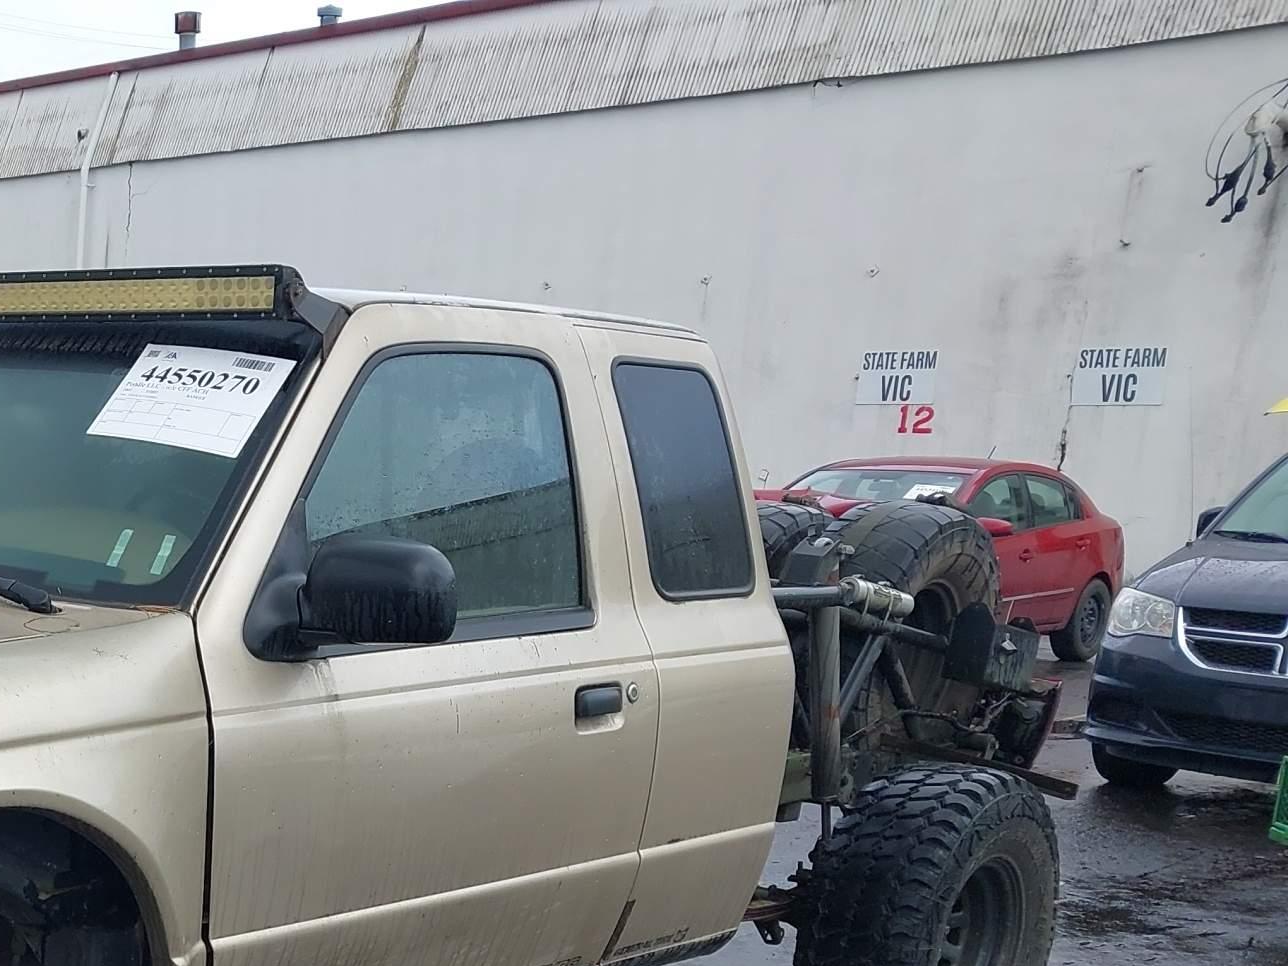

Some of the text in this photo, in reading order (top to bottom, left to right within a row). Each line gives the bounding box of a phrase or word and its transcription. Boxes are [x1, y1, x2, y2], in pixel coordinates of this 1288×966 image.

[862, 350, 938, 371] STATE FARM
[1079, 347, 1167, 368] STATE FARM
[140, 365, 261, 395] 44550270
[880, 374, 913, 402] VIC
[1101, 373, 1138, 403] VIC
[897, 405, 935, 434] 12
